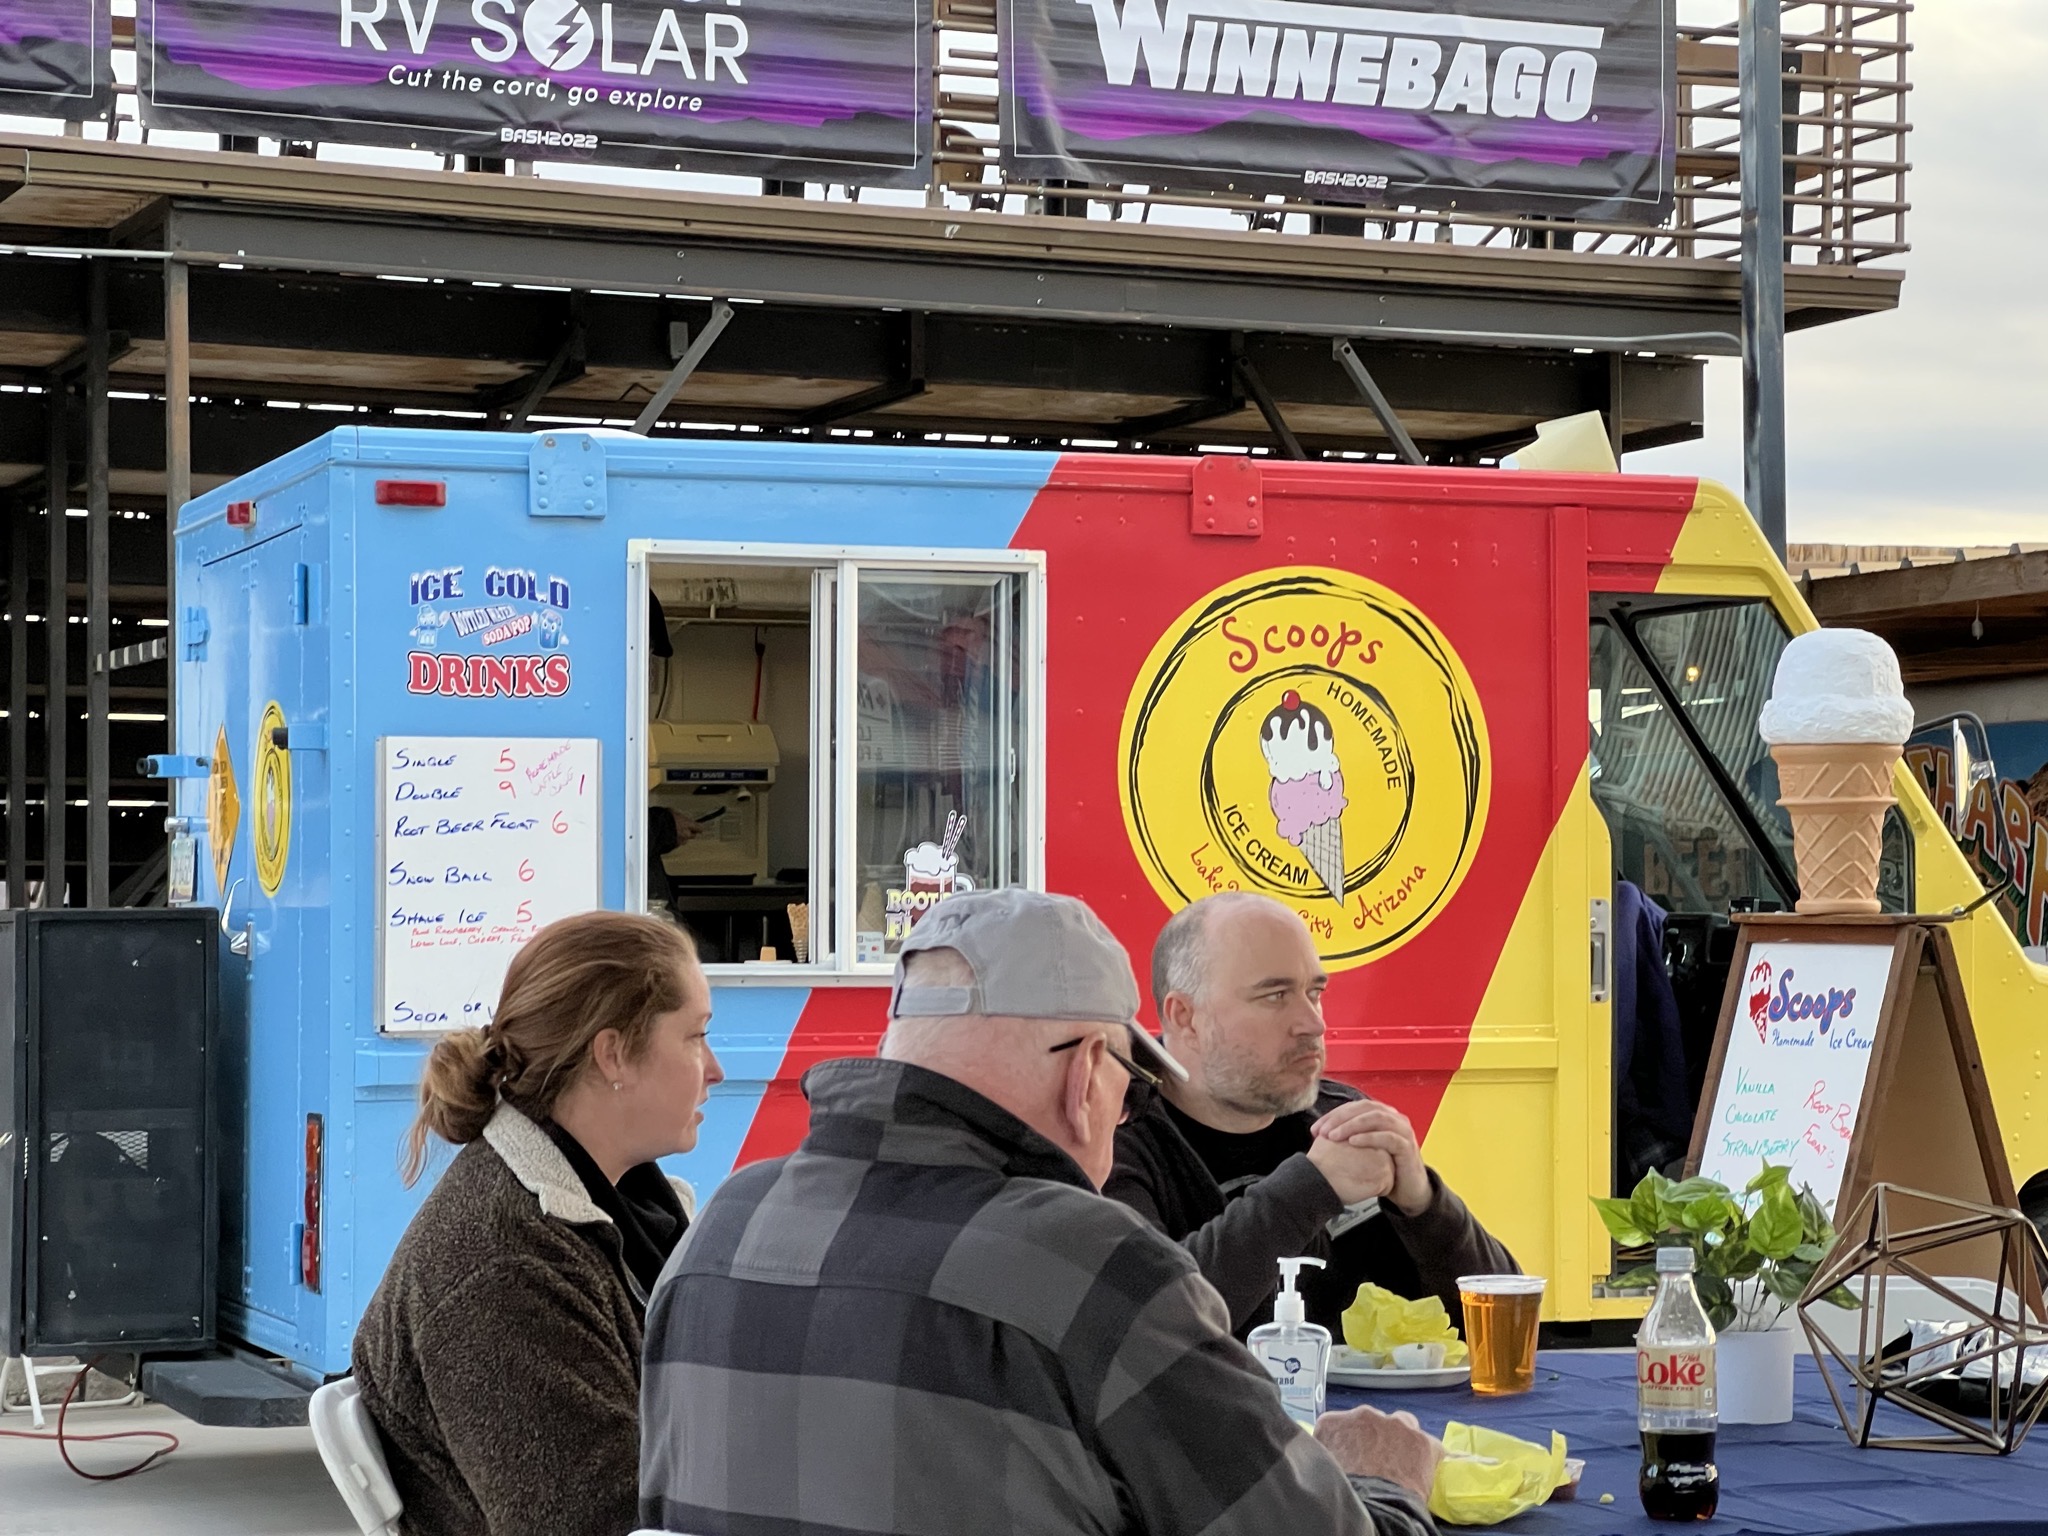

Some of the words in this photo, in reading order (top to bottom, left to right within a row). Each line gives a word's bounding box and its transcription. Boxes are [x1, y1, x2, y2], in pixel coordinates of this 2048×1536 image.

[340, 0, 440, 55] RV
[1076, 0, 1602, 122] WINNEBAGO
[388, 65, 434, 88] Cut
[441, 69, 482, 92] the
[493, 75, 557, 102] cord,
[567, 83, 599, 107] go
[608, 88, 703, 112] explore
[500, 126, 599, 149] BASH2022
[1303, 169, 1389, 189] BASH2022
[411, 567, 464, 605] ICE
[485, 566, 570, 609] COLD
[483, 625, 513, 646] SODA
[511, 615, 532, 636] POP
[1221, 615, 1384, 673] Scoops
[407, 651, 570, 698] DRINKS
[1326, 681, 1402, 790] HOMEMADE
[493, 748, 516, 772] 5
[498, 780, 516, 799] 9
[394, 815, 430, 838] ROOT
[435, 820, 485, 836] BEER
[489, 811, 540, 831] FLOAT
[552, 810, 569, 834] 6
[1223, 804, 1251, 842] ICE
[1245, 838, 1310, 886] CREAM
[388, 860, 435, 886] SNOW
[445, 866, 494, 884] BALL
[518, 858, 535, 883] 6
[1190, 842, 1224, 893] Lake
[1353, 865, 1427, 930] Arizona
[458, 908, 488, 924] ICE
[516, 899, 533, 924] 5
[887, 889, 938, 911] ROOT
[393, 1001, 448, 1023] SODA
[1768, 968, 1857, 1035] Scoops
[1771, 1028, 1816, 1047] Homemade
[1829, 1028, 1843, 1050] Ice
[1637, 1350, 1706, 1387] Coke
